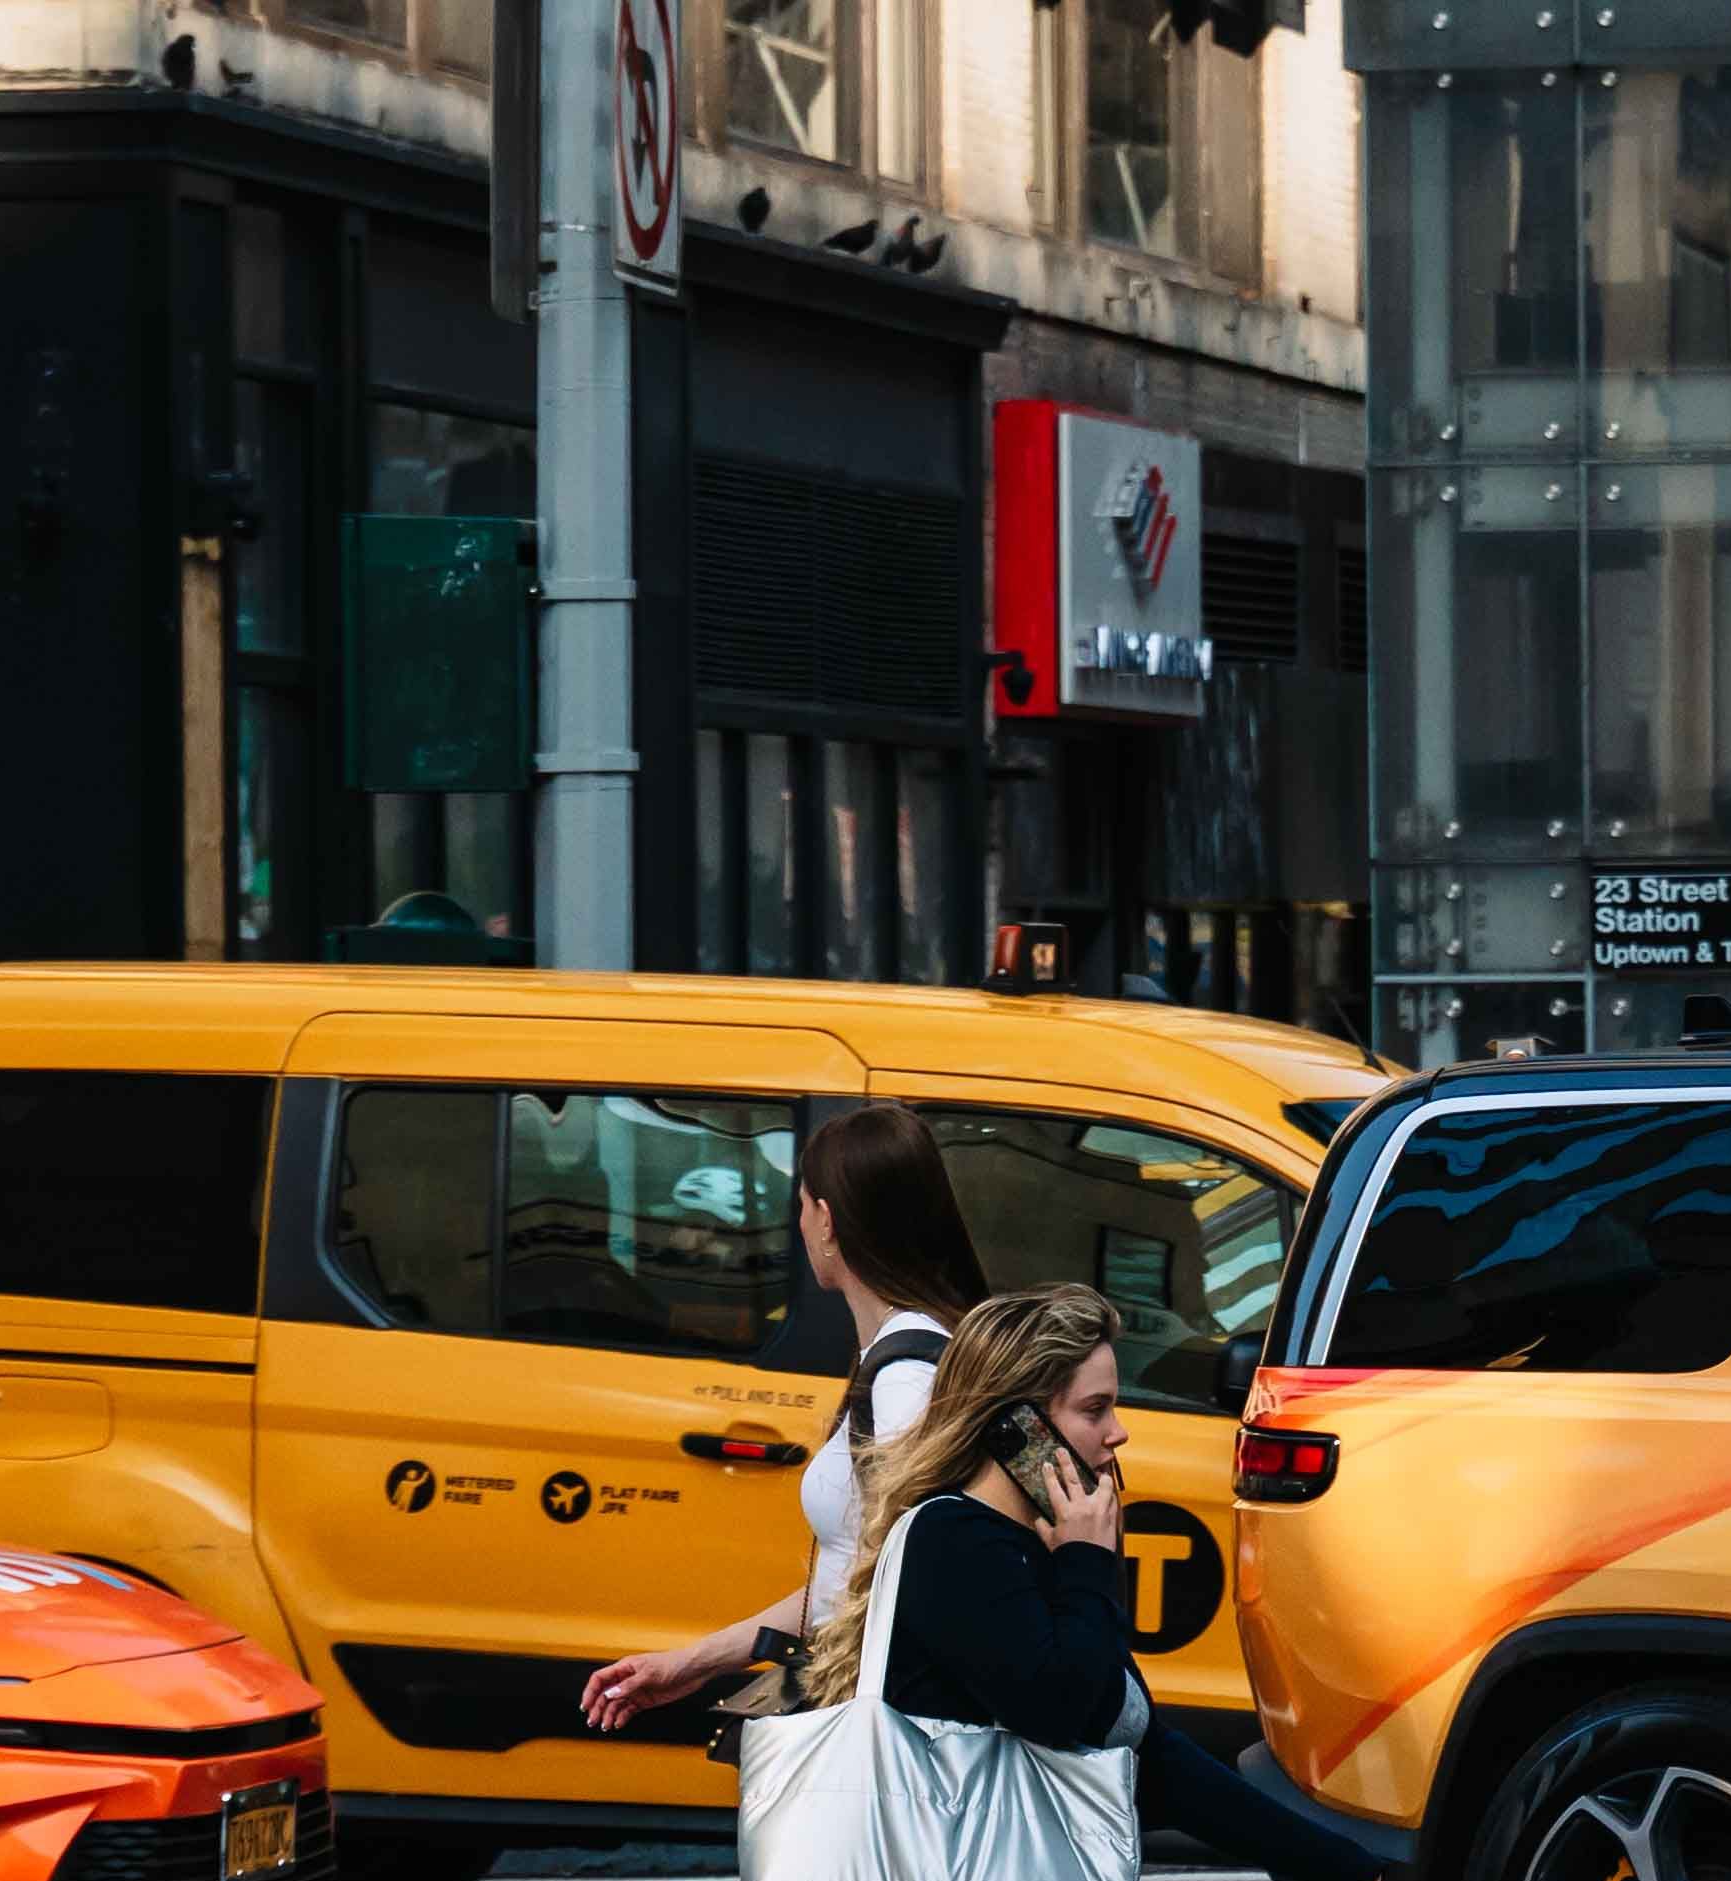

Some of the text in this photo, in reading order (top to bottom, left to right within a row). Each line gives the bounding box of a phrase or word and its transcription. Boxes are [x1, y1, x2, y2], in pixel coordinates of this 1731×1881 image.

[1594, 879, 1631, 903] 23
[1638, 877, 1730, 903] Street
[1594, 907, 1700, 933] Station
[1594, 943, 1689, 968] Uptown
[1695, 942, 1714, 964] &
[1124, 1533, 1192, 1633] T
